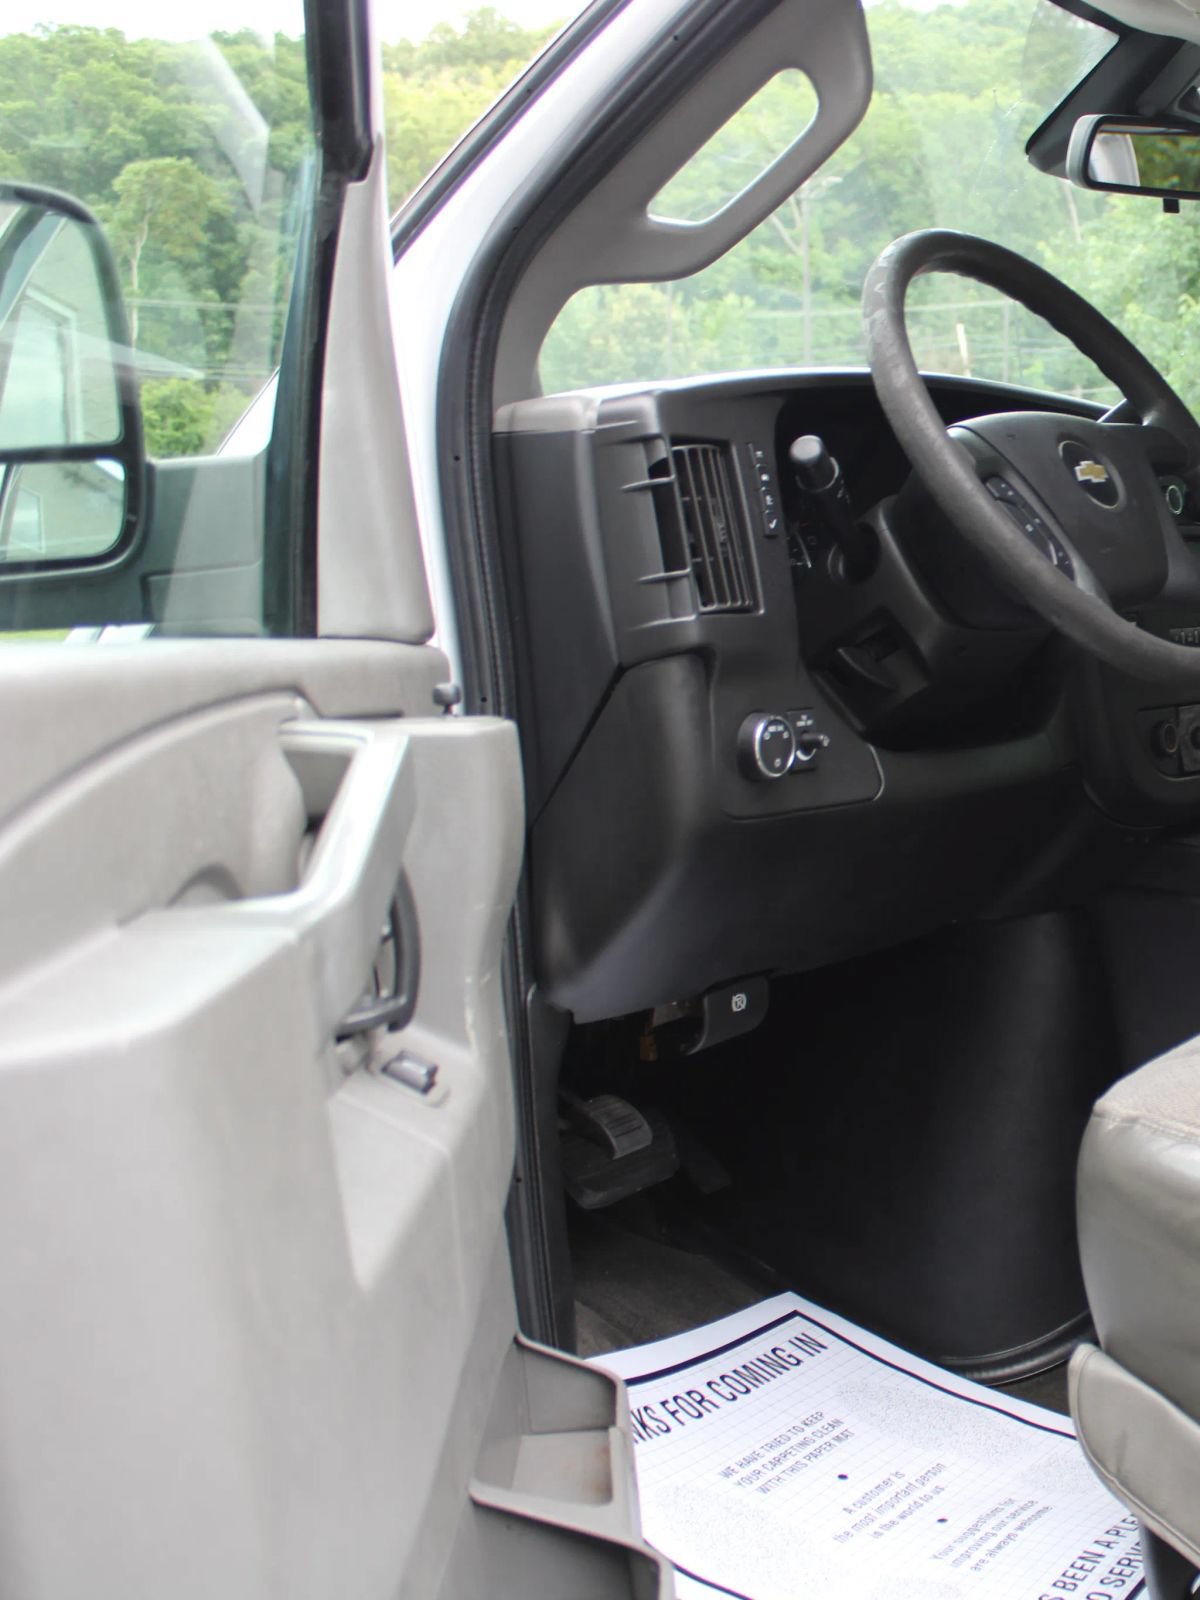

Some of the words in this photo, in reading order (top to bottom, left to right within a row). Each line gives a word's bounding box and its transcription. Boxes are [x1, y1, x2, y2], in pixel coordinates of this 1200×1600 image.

[630, 1406, 671, 1443] NKS
[660, 1389, 720, 1426] FOR
[706, 1346, 803, 1402] COMING
[788, 1332, 828, 1357] IN
[719, 1466, 740, 1479] WE
[735, 1451, 765, 1469] HAVE
[760, 1434, 791, 1452] TRIED
[787, 1425, 805, 1436] TO
[801, 1411, 824, 1427] KEEP
[735, 1469, 766, 1487] YOUR
[761, 1436, 816, 1471] CARPETING
[811, 1419, 844, 1438] CLEAN
[756, 1475, 786, 1494] WITH
[781, 1460, 808, 1477] THIS
[803, 1441, 837, 1463] PAPER
[832, 1428, 855, 1444] MAT
[832, 1530, 853, 1544] the
[851, 1512, 877, 1532] most
[873, 1482, 917, 1515] important
[915, 1463, 946, 1487] person
[842, 1507, 855, 1515] A
[852, 1477, 895, 1509] customer
[890, 1471, 905, 1480] is
[879, 1519, 899, 1532] the
[896, 1500, 924, 1520] world
[918, 1494, 934, 1503] to
[950, 1532, 998, 1568] improving
[991, 1520, 1008, 1532] our
[1093, 1540, 1120, 1550] A
[1104, 1514, 1140, 1538] PLE
[929, 1545, 955, 1560] Your
[970, 1559, 989, 1572] are
[985, 1532, 1018, 1558] always
[1052, 1550, 1106, 1592] BEEN
[1099, 1541, 1143, 1588] SERV
